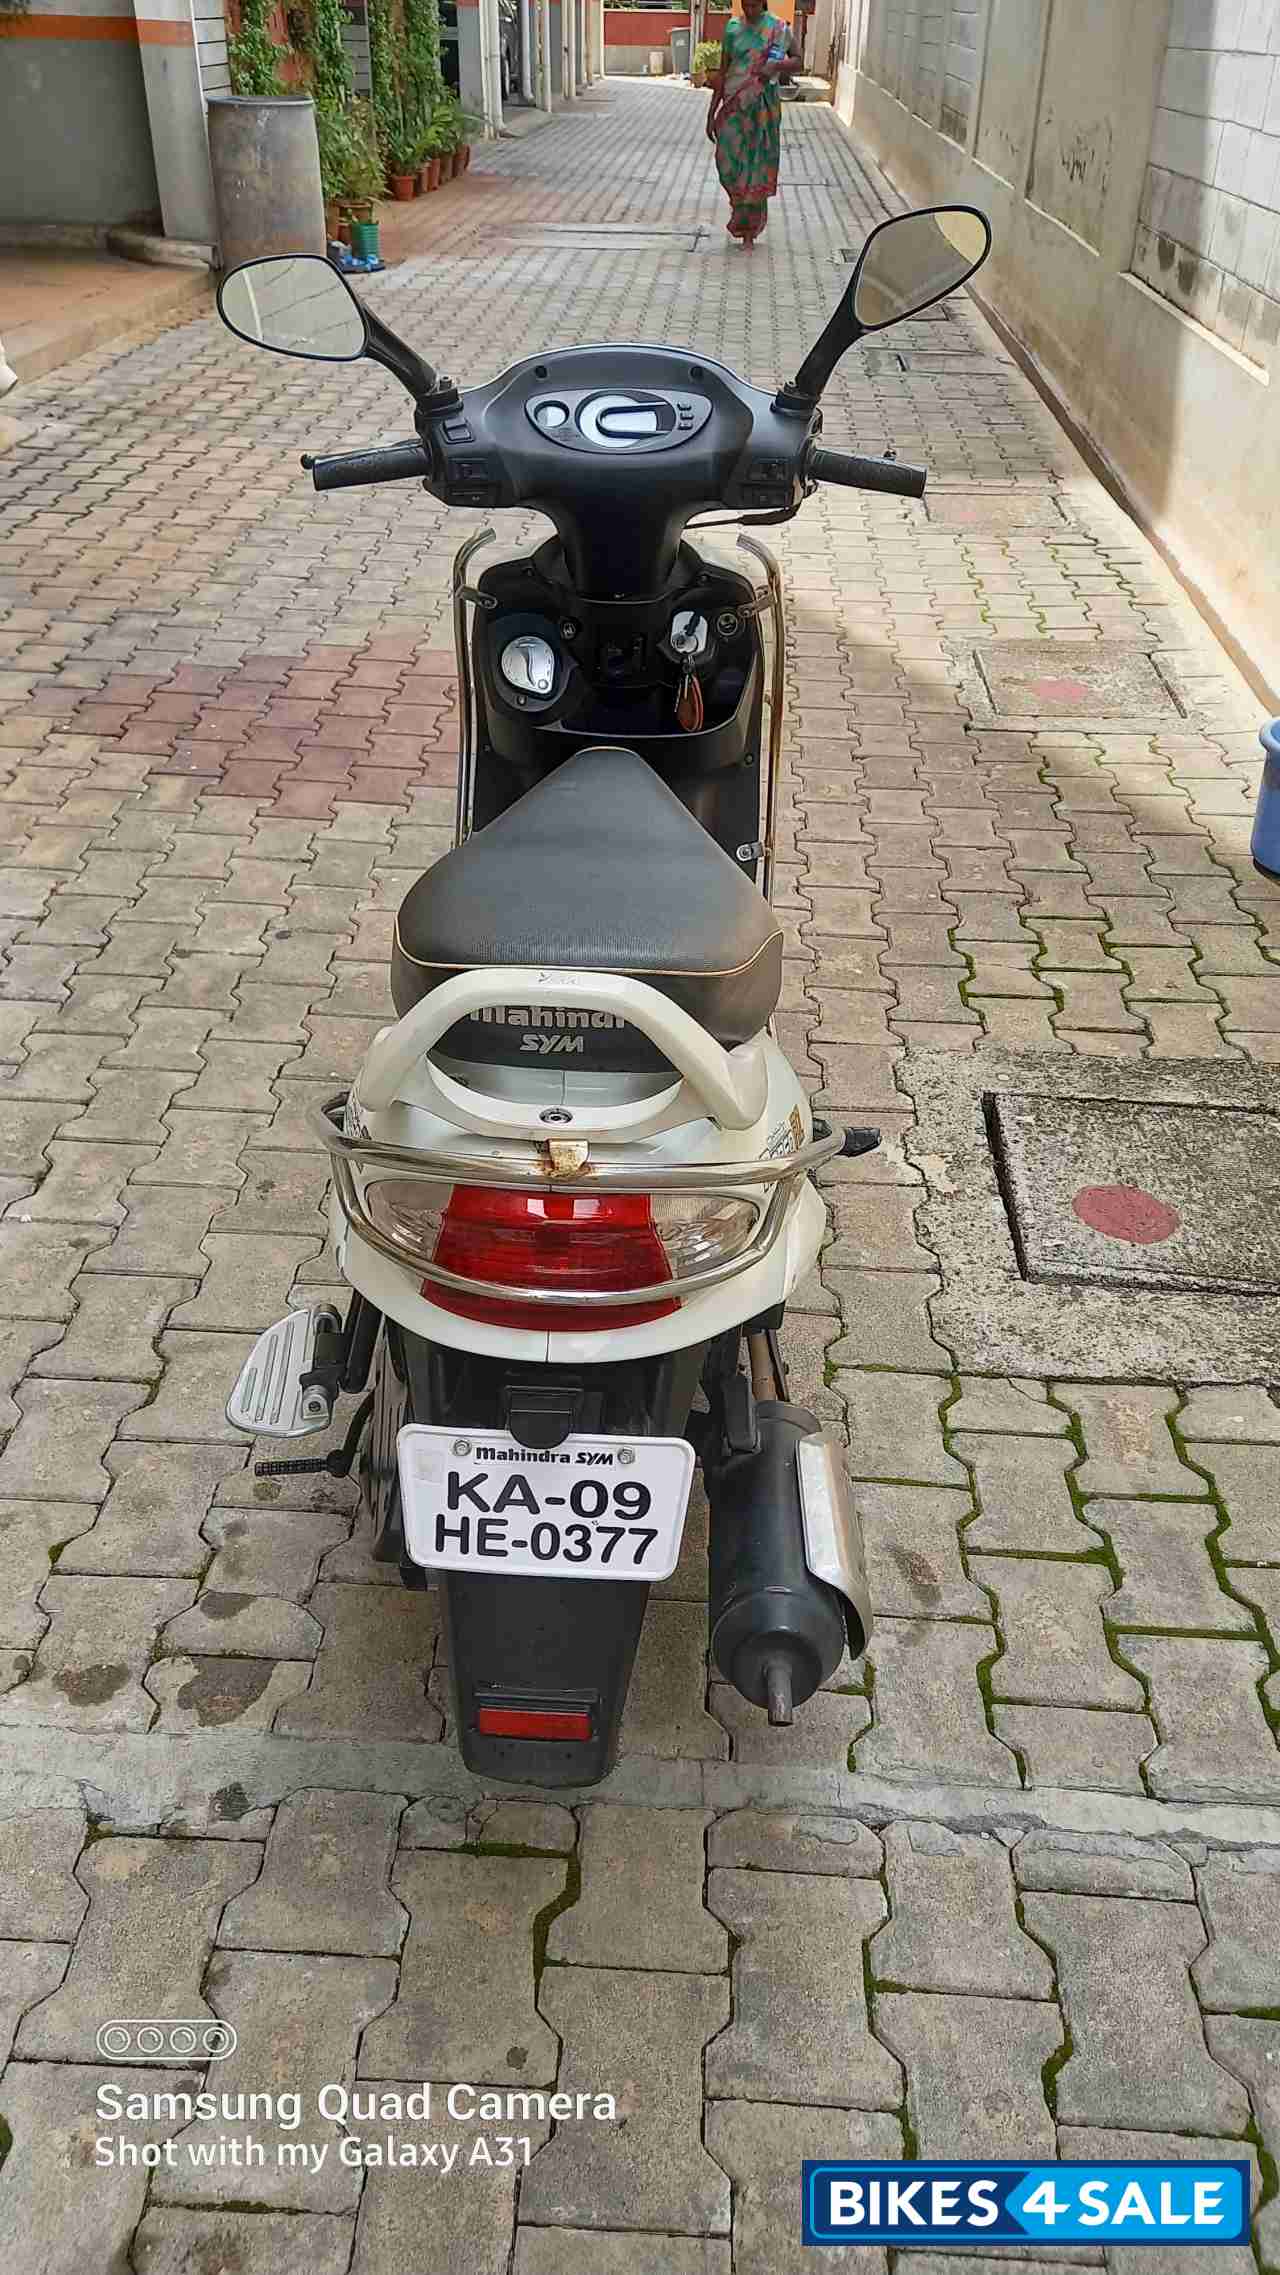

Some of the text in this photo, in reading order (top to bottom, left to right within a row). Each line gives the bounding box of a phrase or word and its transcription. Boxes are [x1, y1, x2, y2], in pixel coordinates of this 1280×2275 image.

[520, 1033, 584, 1054] SYM
[575, 1452, 613, 1465] SYM
[447, 1471, 651, 1520] KA-09
[435, 1514, 659, 1564] HE-0377
